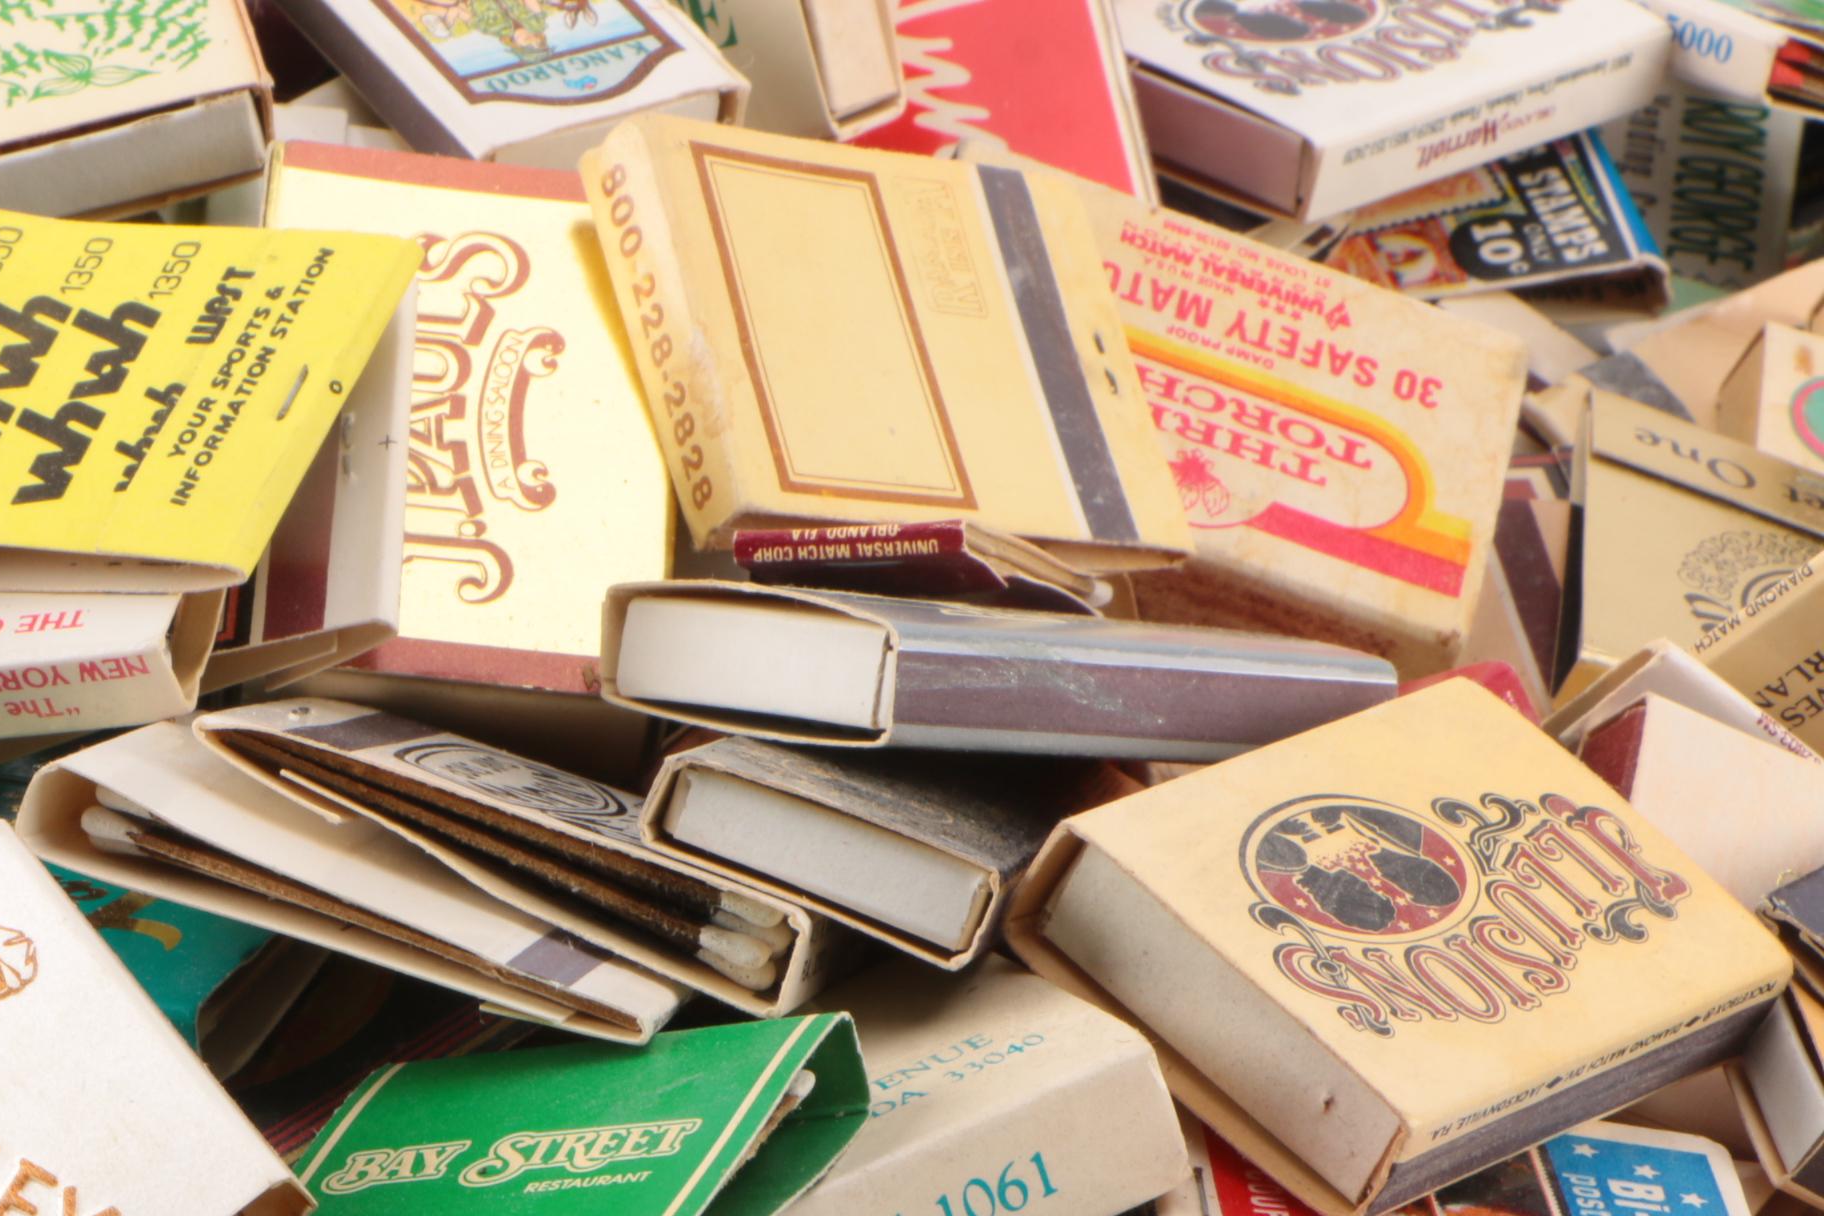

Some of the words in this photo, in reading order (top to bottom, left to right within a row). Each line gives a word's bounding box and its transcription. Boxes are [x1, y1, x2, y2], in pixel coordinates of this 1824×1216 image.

[486, 37, 656, 92] KANGAROO
[1417, 122, 1501, 170] Marriott
[1517, 164, 1609, 263] STAMPS
[60, 236, 114, 297] 1350
[149, 240, 203, 301] 1350
[598, 161, 714, 512] 800-228-2828
[1220, 309, 1381, 390] SAFETY
[1244, 343, 1276, 370] DAMP
[169, 397, 218, 459] YOUR
[217, 303, 272, 393] SPORTS
[265, 284, 286, 302] &
[169, 345, 278, 507] INFORMATION
[269, 245, 336, 341] STATION
[488, 335, 524, 408] SALOON
[1391, 368, 1445, 411] 30
[485, 410, 511, 470] DINING
[752, 543, 808, 564] CORP
[810, 541, 858, 562] MATCH
[863, 539, 939, 560] UNIVERSAL
[1745, 562, 1816, 620] DIAMOND
[13, 608, 87, 636] THE
[79, 655, 152, 682] NEW
[8, 699, 81, 719] "The
[1271, 792, 1693, 1040] ILLUSIONS
[942, 1033, 1047, 1085] 33040
[1629, 1021, 1685, 1054] DIAMOND
[320, 1139, 472, 1196] BAY
[458, 1118, 703, 1188] STREET
[522, 1170, 653, 1195] RESTAURANT
